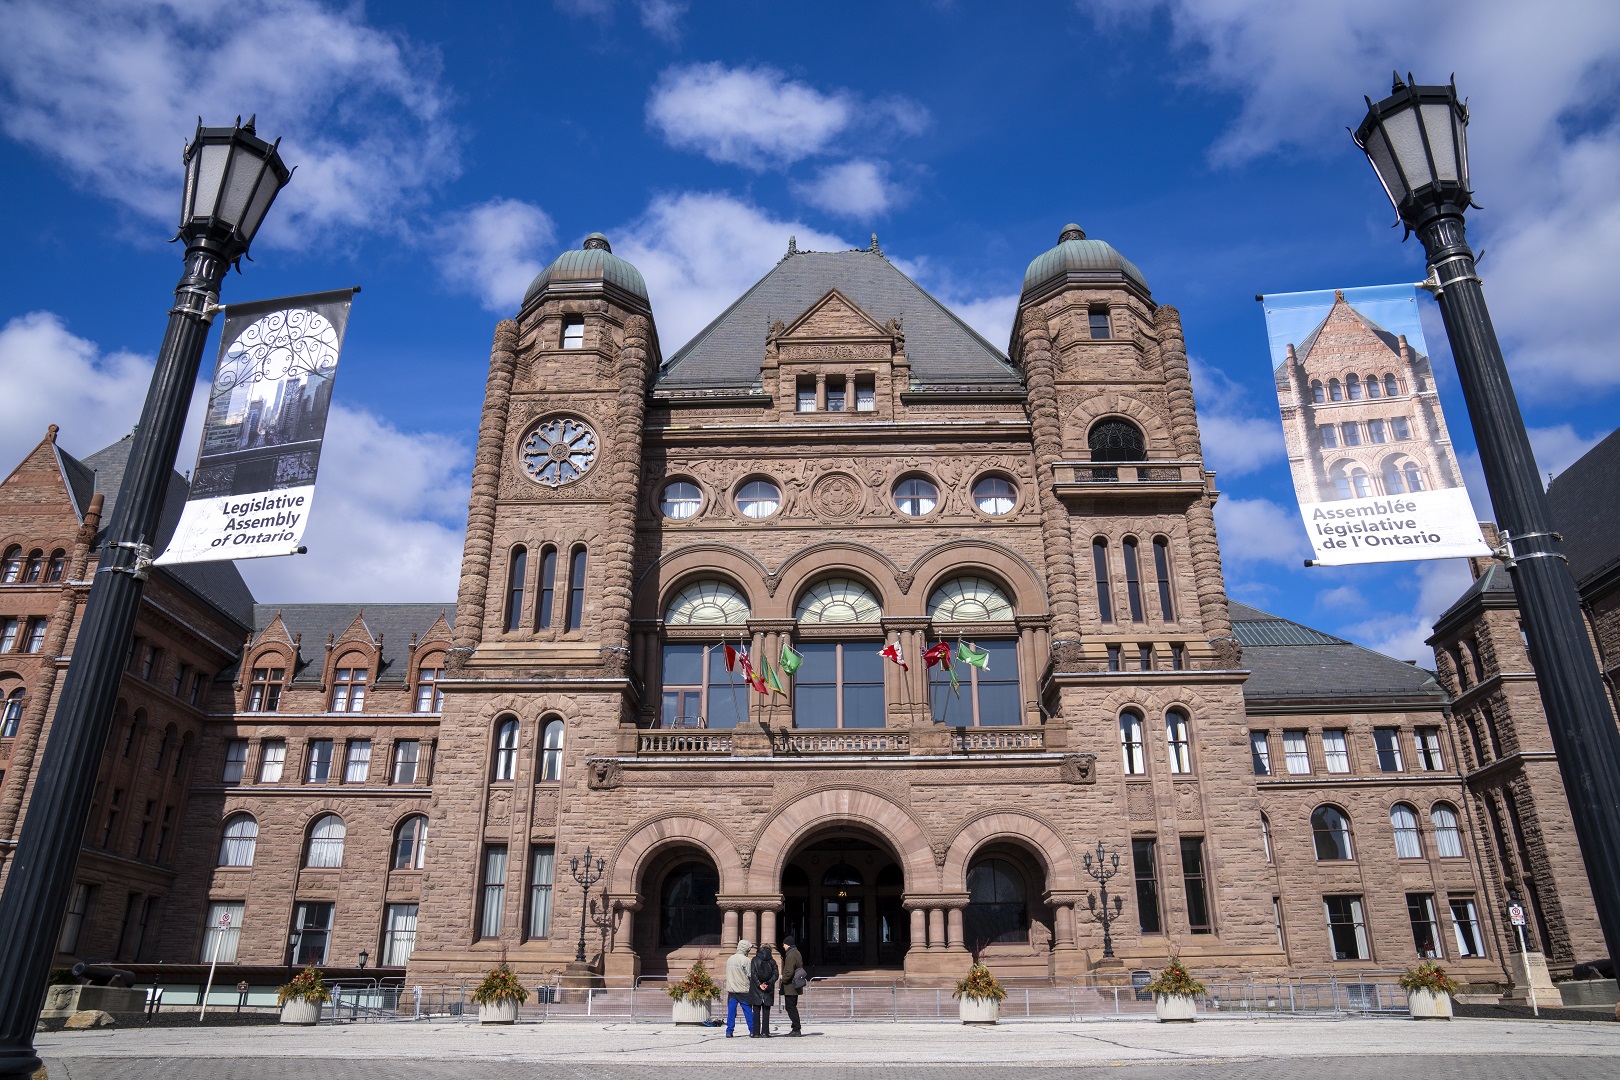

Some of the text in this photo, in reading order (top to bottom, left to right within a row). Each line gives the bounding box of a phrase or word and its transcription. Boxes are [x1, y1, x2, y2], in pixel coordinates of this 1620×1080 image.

[223, 494, 304, 516] Legislative
[1312, 499, 1417, 520] Assemblée
[224, 511, 300, 531] Assembly
[1316, 518, 1417, 537] législative
[211, 529, 295, 547] of Ontario
[1322, 531, 1441, 549] de l'Ontario
